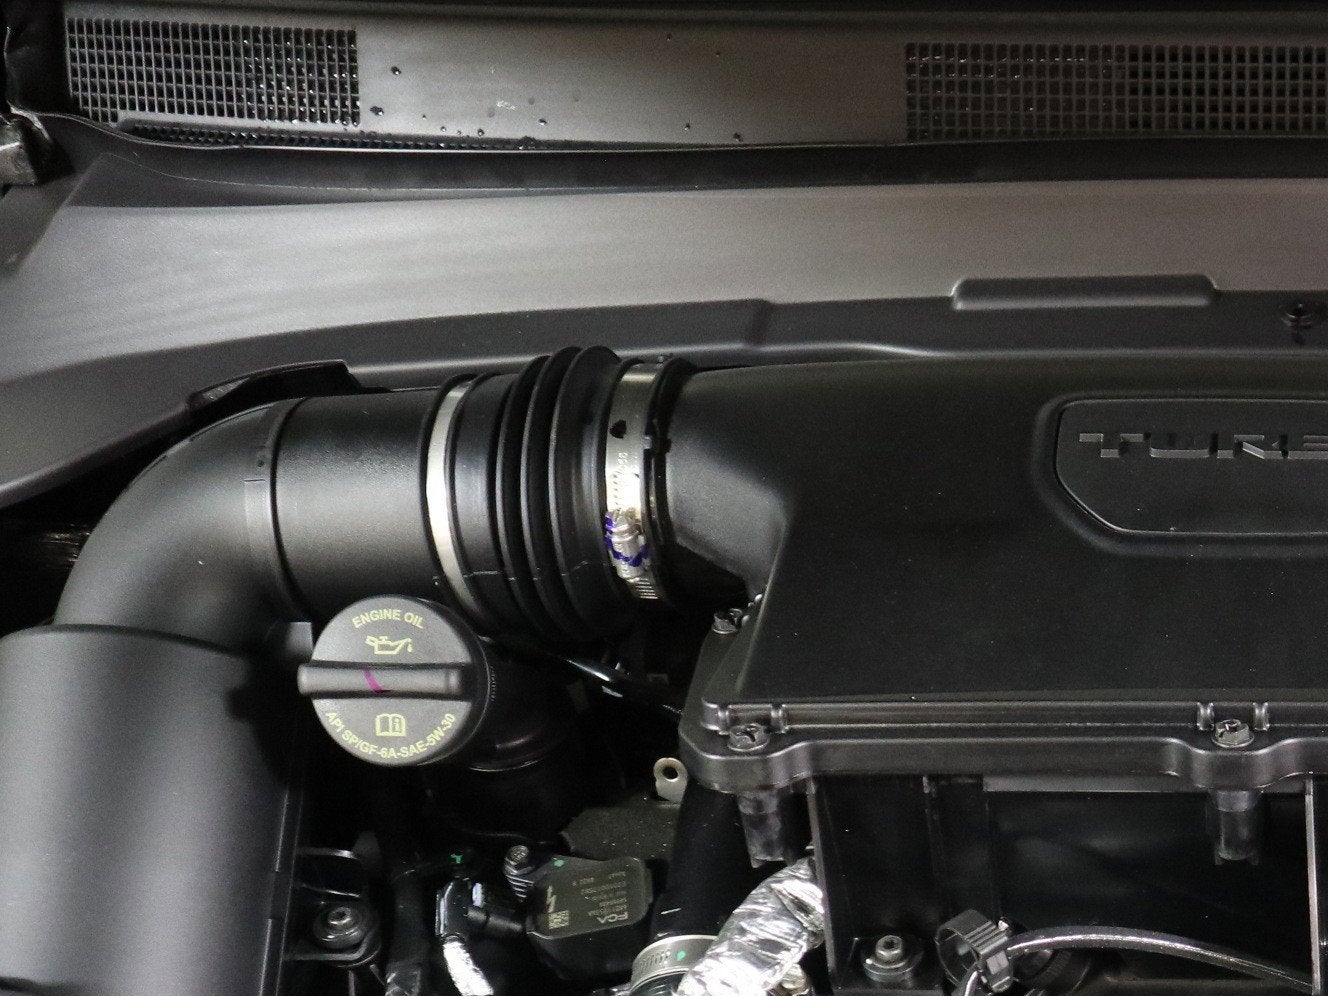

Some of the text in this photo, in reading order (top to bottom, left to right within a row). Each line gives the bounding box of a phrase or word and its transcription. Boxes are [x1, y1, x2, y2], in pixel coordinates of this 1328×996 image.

[351, 608, 425, 630] ENGINE OIL
[325, 711, 343, 733] API
[596, 911, 629, 924] FCA
